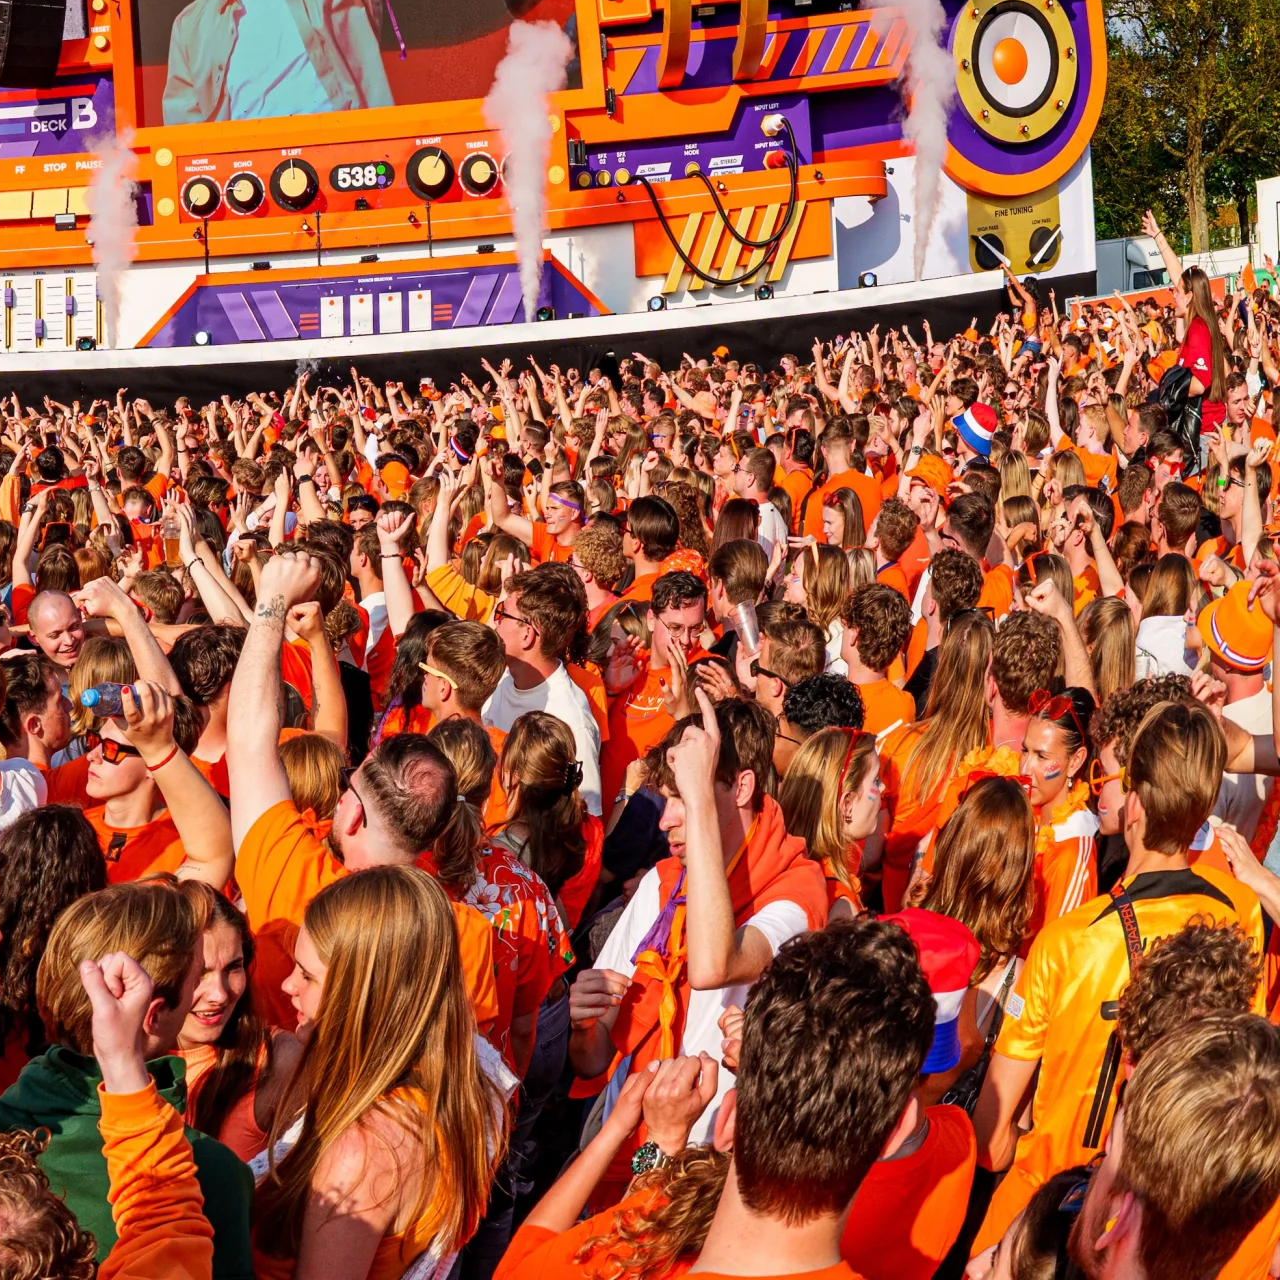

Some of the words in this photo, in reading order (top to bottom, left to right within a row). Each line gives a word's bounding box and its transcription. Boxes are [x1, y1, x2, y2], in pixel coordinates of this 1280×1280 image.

[90, 25, 111, 33] RESET
[70, 97, 98, 130] B
[30, 118, 68, 134] DECK
[422, 136, 442, 145] RIGHT
[465, 140, 489, 149] TREBLE
[287, 148, 303, 156] LEFT
[75, 159, 104, 171] PAUSE
[233, 160, 253, 168] ECHO
[720, 157, 738, 165] STEREO
[15, 165, 26, 175] FF
[43, 162, 68, 173] STOP
[337, 165, 378, 189] 538
[994, 208, 1009, 218] FINE
[1010, 205, 1034, 216] TUNING
